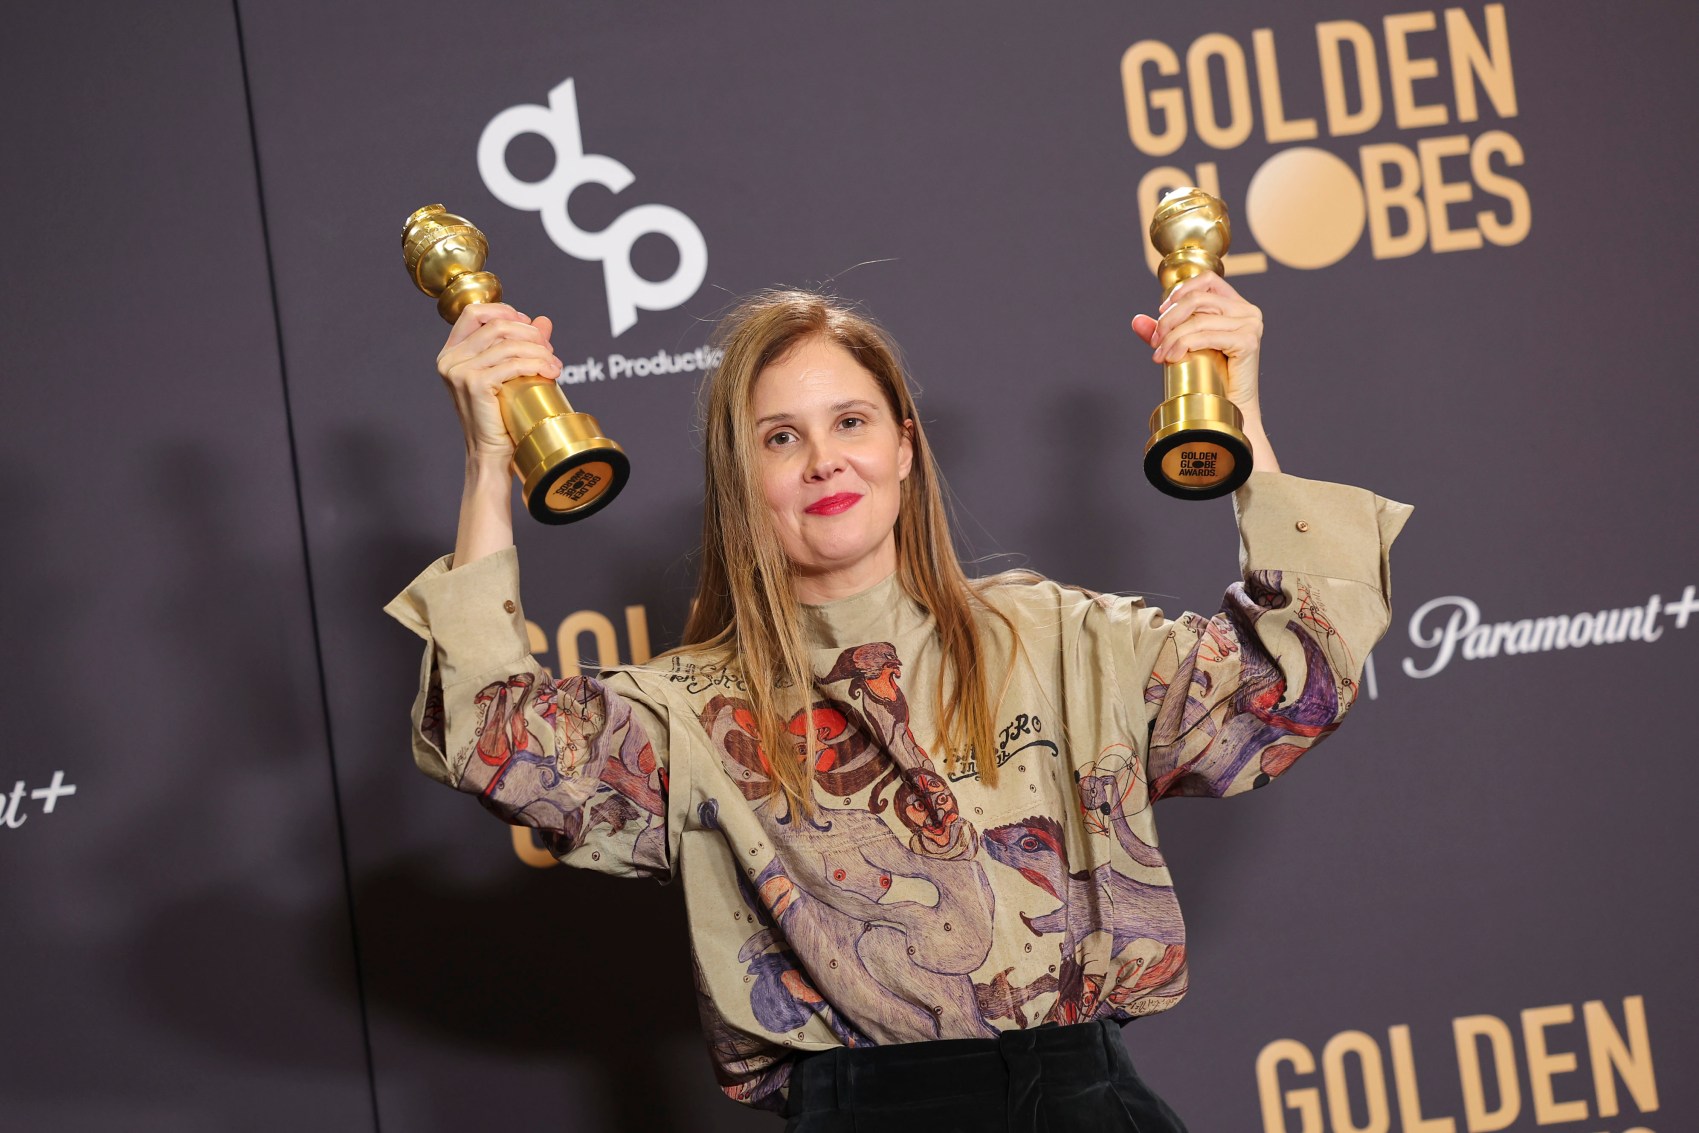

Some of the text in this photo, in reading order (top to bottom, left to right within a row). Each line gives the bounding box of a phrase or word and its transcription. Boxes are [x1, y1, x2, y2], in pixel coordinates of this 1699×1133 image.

[1120, 4, 1518, 157] GOLDEN
[1180, 460, 1216, 468] GLOBE
[1181, 451, 1217, 460] GOLDEN
[1402, 585, 1699, 678] Paramount+
[1255, 996, 1659, 1133] GOLDEN
